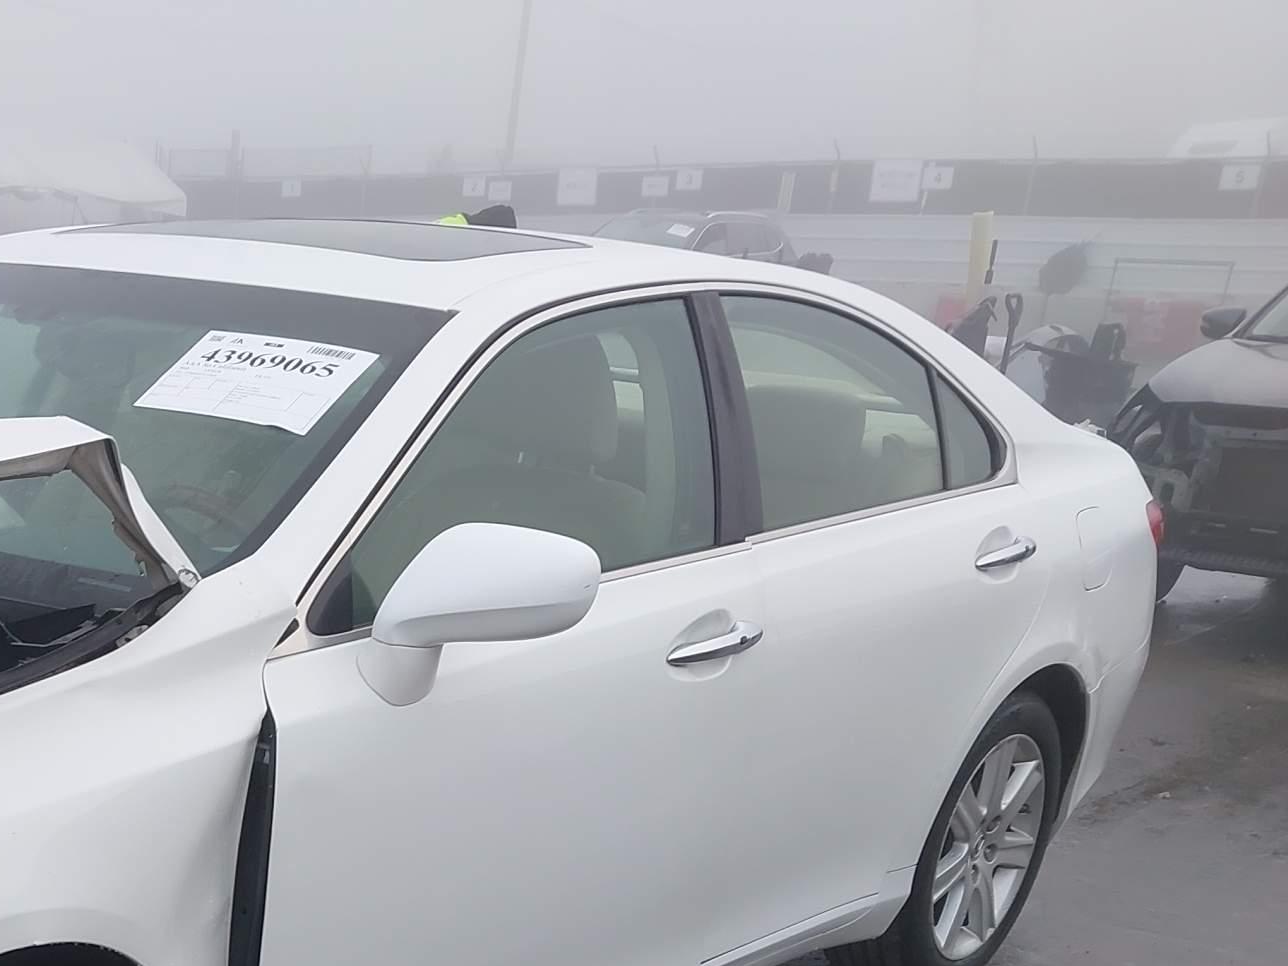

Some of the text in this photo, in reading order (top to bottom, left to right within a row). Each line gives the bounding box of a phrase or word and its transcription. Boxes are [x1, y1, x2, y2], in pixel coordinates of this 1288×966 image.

[933, 172, 942, 185] 4
[1234, 169, 1246, 184] 5
[201, 348, 339, 377] 43969065
